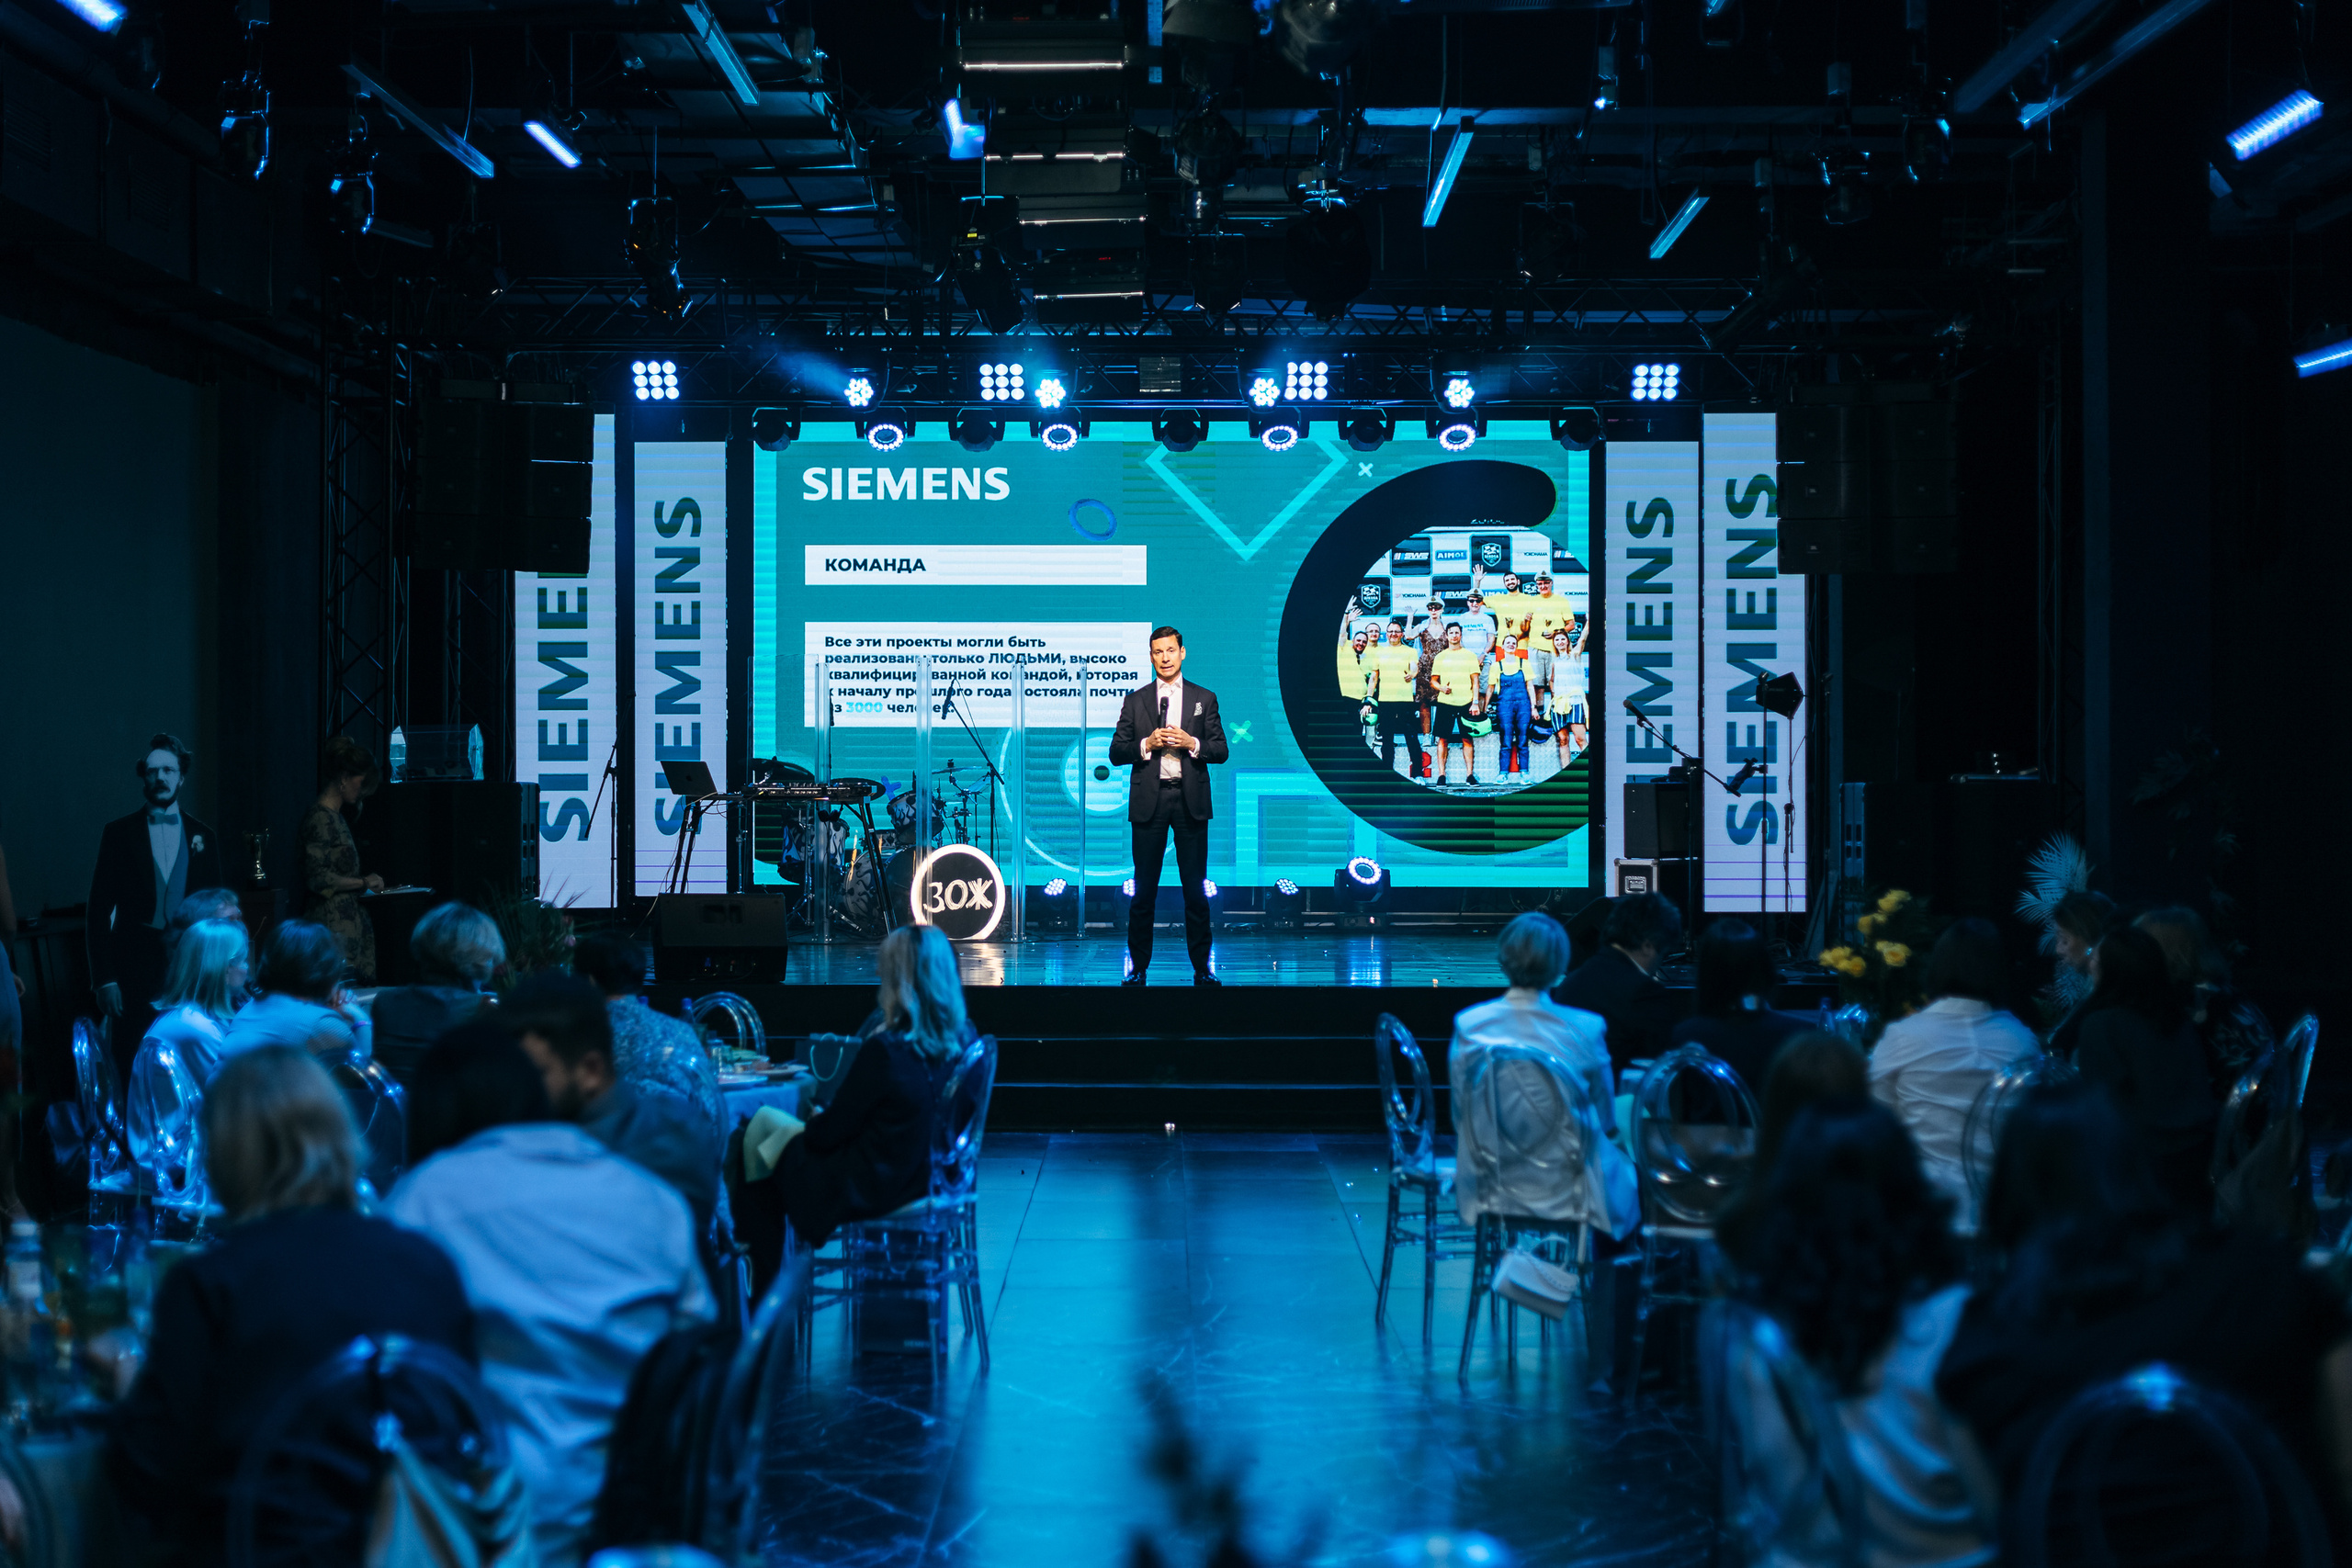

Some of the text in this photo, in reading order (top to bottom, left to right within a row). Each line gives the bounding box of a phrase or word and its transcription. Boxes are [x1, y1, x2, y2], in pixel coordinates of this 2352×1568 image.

[802, 467, 1010, 502] SIEMENS
[825, 558, 926, 572] КОМАНДА
[824, 636, 1046, 649] Все эти проекты могли быть
[1625, 497, 1674, 784] EMENS
[825, 652, 1127, 666] реализован только ЛЮДЬМИ, высоко
[1725, 473, 1779, 845] SIEMENS
[654, 497, 702, 836] SEMENS
[828, 669, 986, 682] квалифицирванной
[990, 669, 1072, 682] коандой,
[838, 687, 891, 699] началу
[901, 687, 973, 699] прлого
[977, 687, 1012, 698] года
[1023, 687, 1082, 697] остоял
[1089, 687, 1135, 697] почти
[537, 571, 589, 842] SIEME
[845, 701, 883, 713] 3000
[888, 703, 955, 714] челе.
